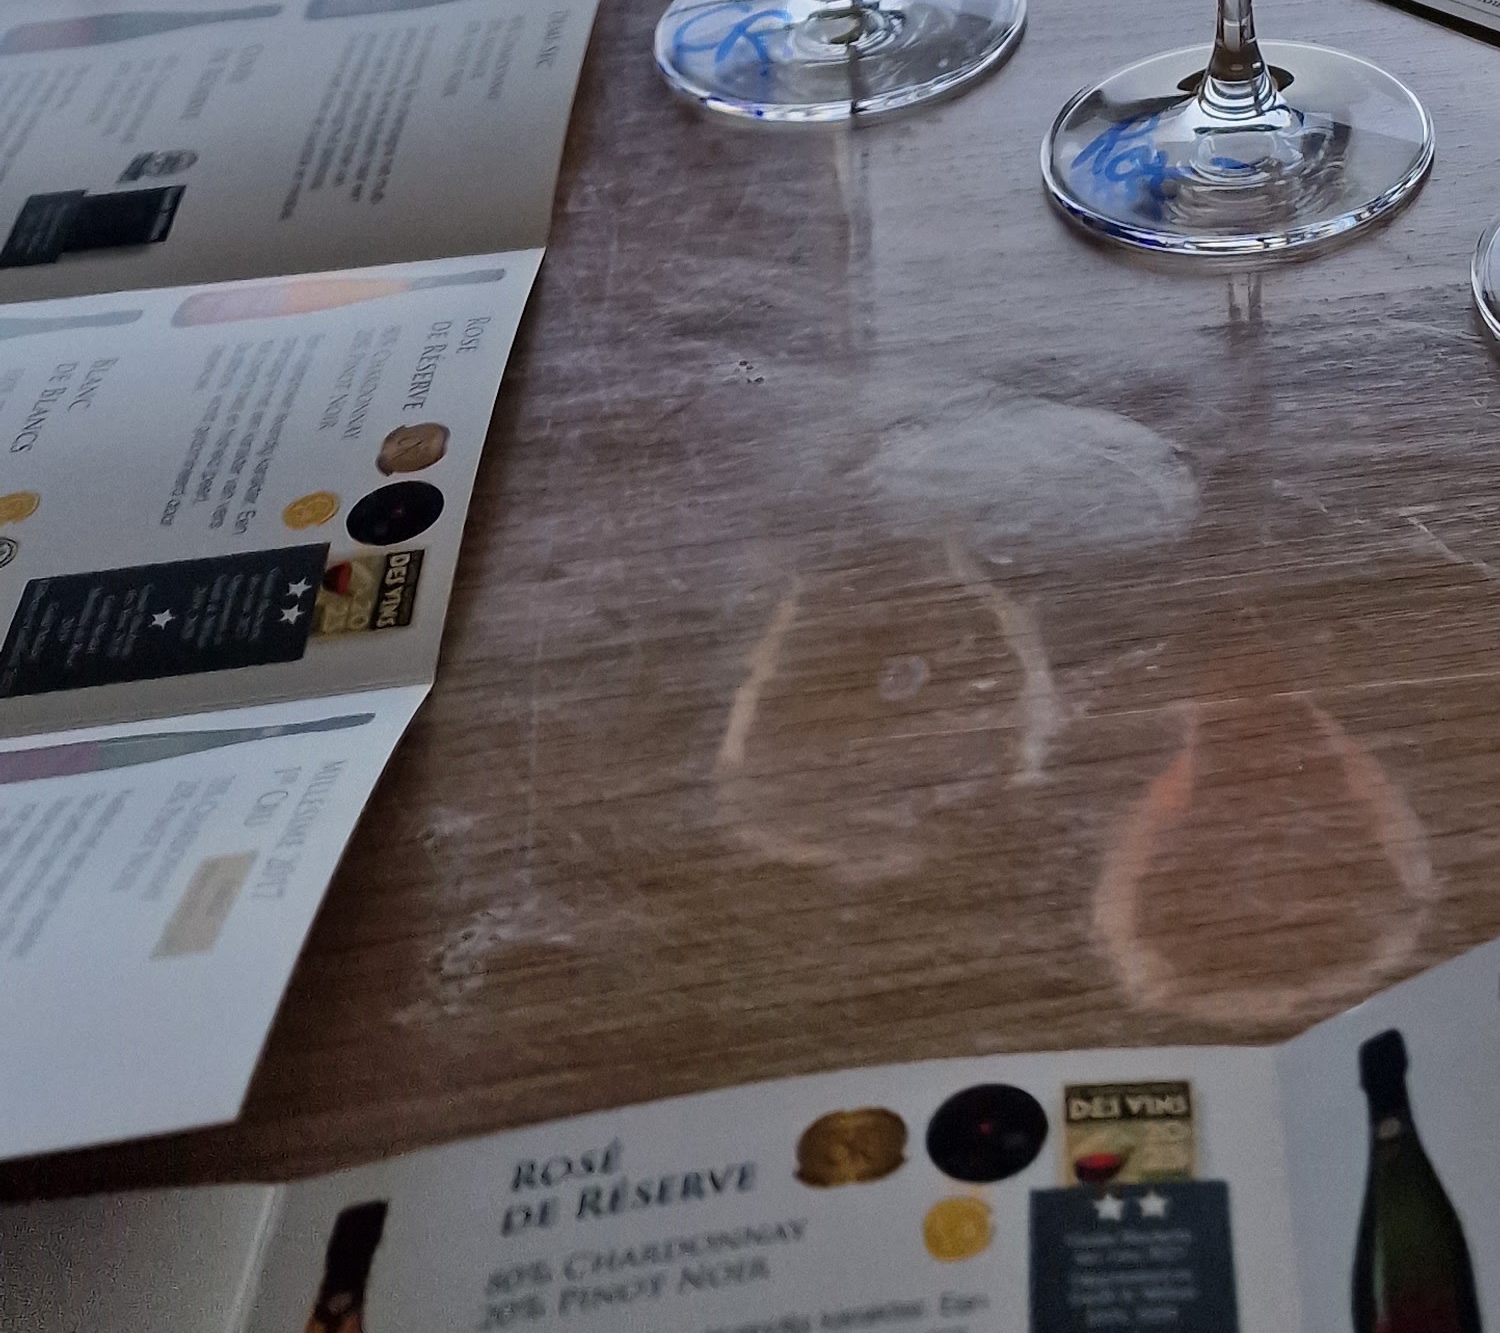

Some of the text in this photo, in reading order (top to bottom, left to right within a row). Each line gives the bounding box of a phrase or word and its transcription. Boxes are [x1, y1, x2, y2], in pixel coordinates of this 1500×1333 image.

[66, 356, 121, 413] BLANC
[402, 320, 454, 412] DE RÉSERVE
[8, 387, 69, 454] BLANCS
[500, 1160, 756, 1239] DE RÉSERVE
[561, 1218, 808, 1282] CHARDONNAY
[555, 1274, 669, 1317] PINOT
